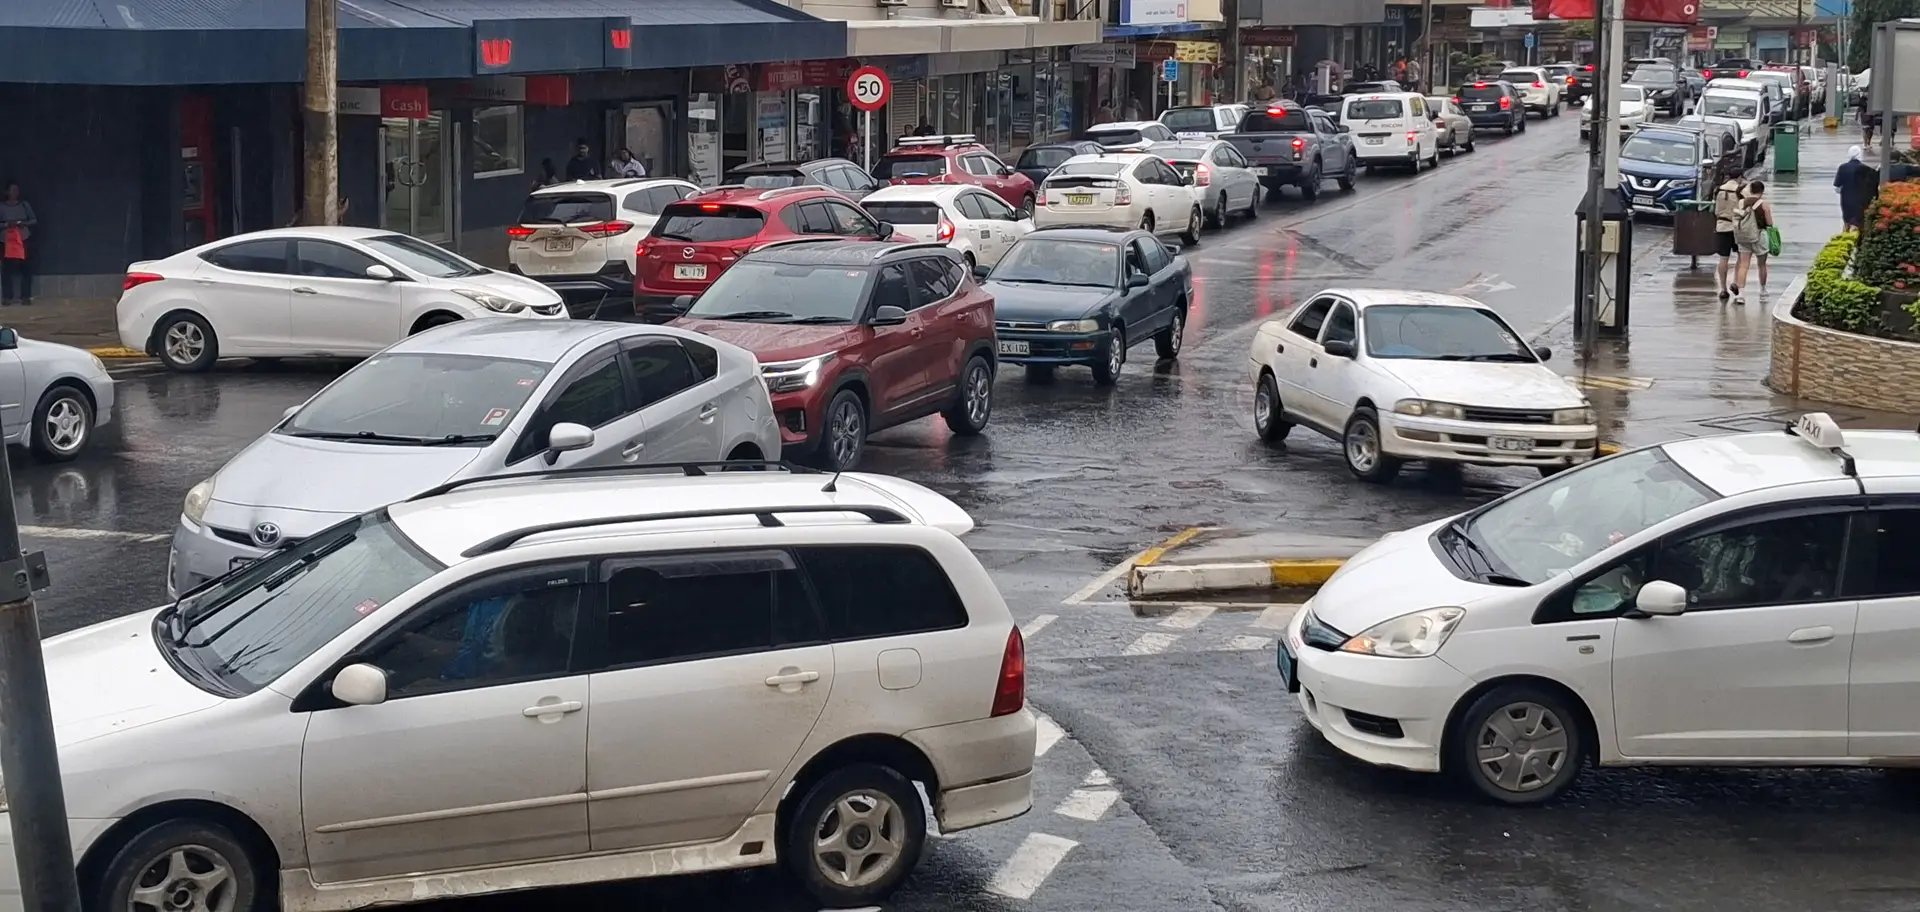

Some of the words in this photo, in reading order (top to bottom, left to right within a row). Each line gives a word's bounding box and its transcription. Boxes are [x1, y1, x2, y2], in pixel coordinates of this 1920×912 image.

[857, 81, 880, 96] 50
[390, 98, 421, 112] Cash
[692, 267, 704, 277] 179
[1015, 343, 1028, 353] 102
[483, 409, 507, 424] P
[1801, 415, 1821, 438] TAXI
